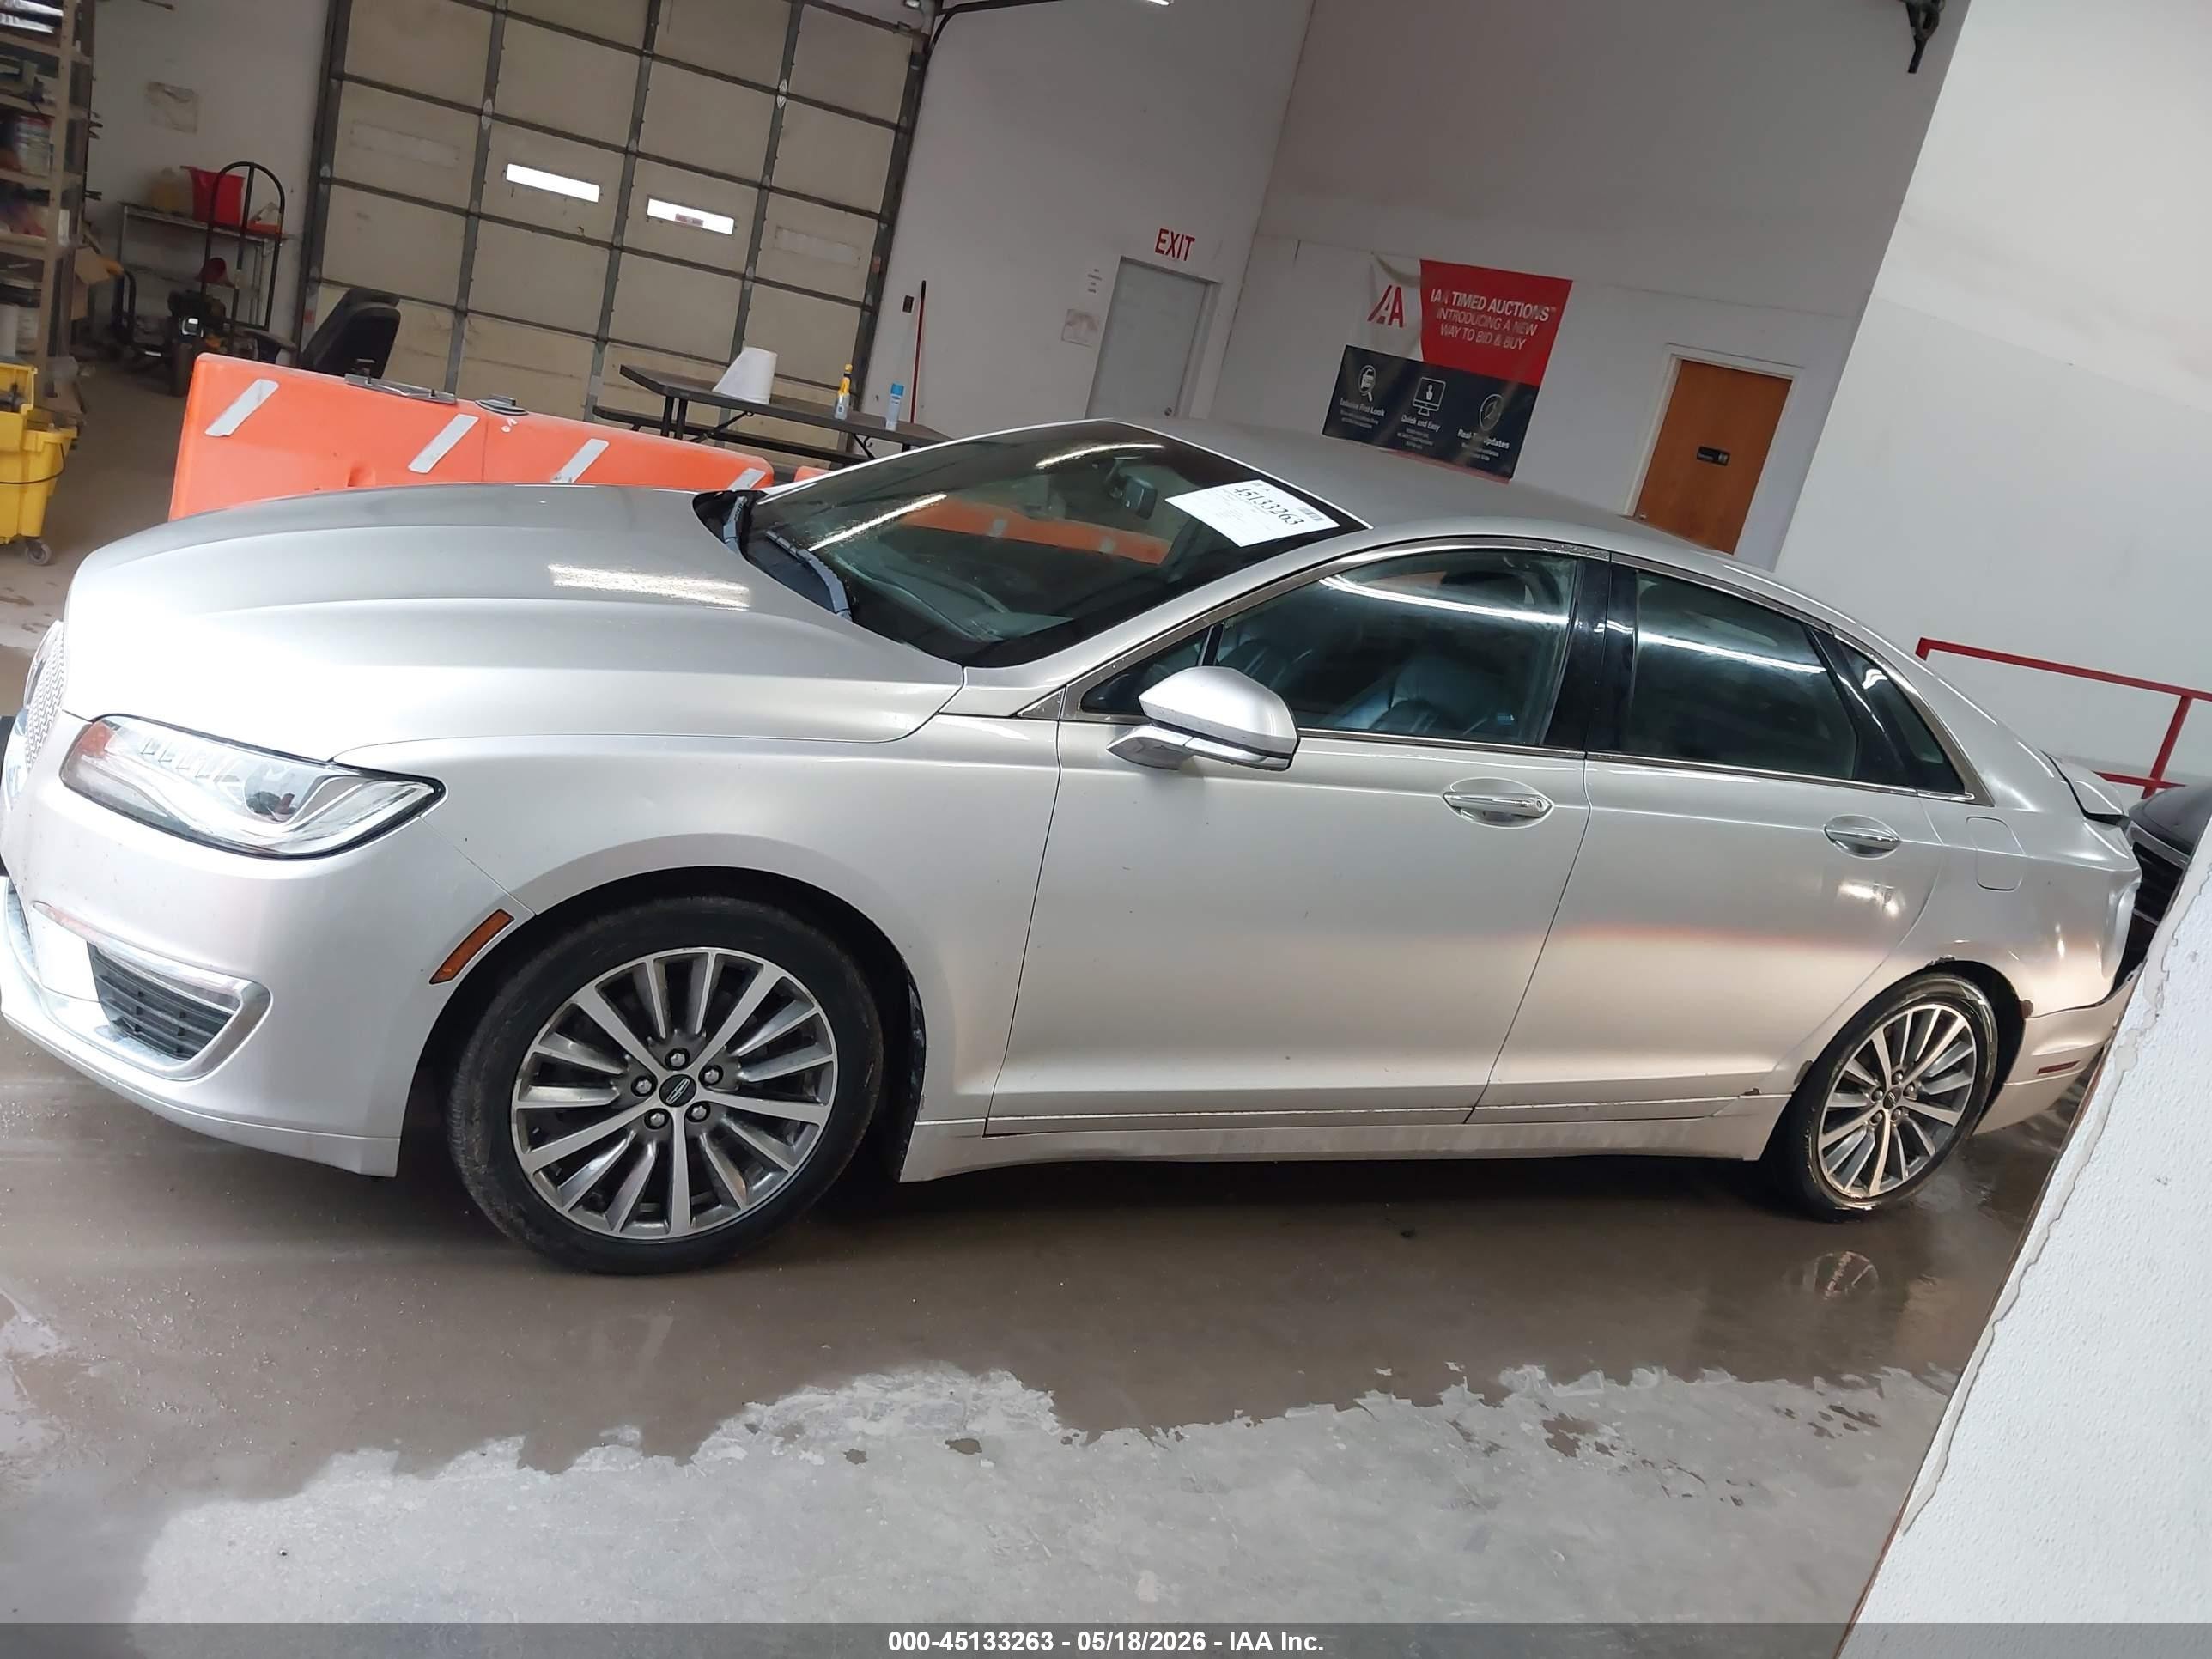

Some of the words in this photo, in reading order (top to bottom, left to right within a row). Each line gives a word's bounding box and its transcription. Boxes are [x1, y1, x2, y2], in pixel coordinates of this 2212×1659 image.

[1155, 228, 1195, 261] EXIT
[1452, 291, 1487, 310] TIMED
[1437, 308, 1502, 331] INTRODUCING
[1503, 320, 1510, 331] A
[1440, 324, 1462, 337] WAY
[1462, 327, 1475, 341] TO
[1475, 331, 1492, 344] BID
[1493, 335, 1501, 346] &
[1503, 336, 1527, 350] BUY
[1234, 487, 1305, 526] 45133263
